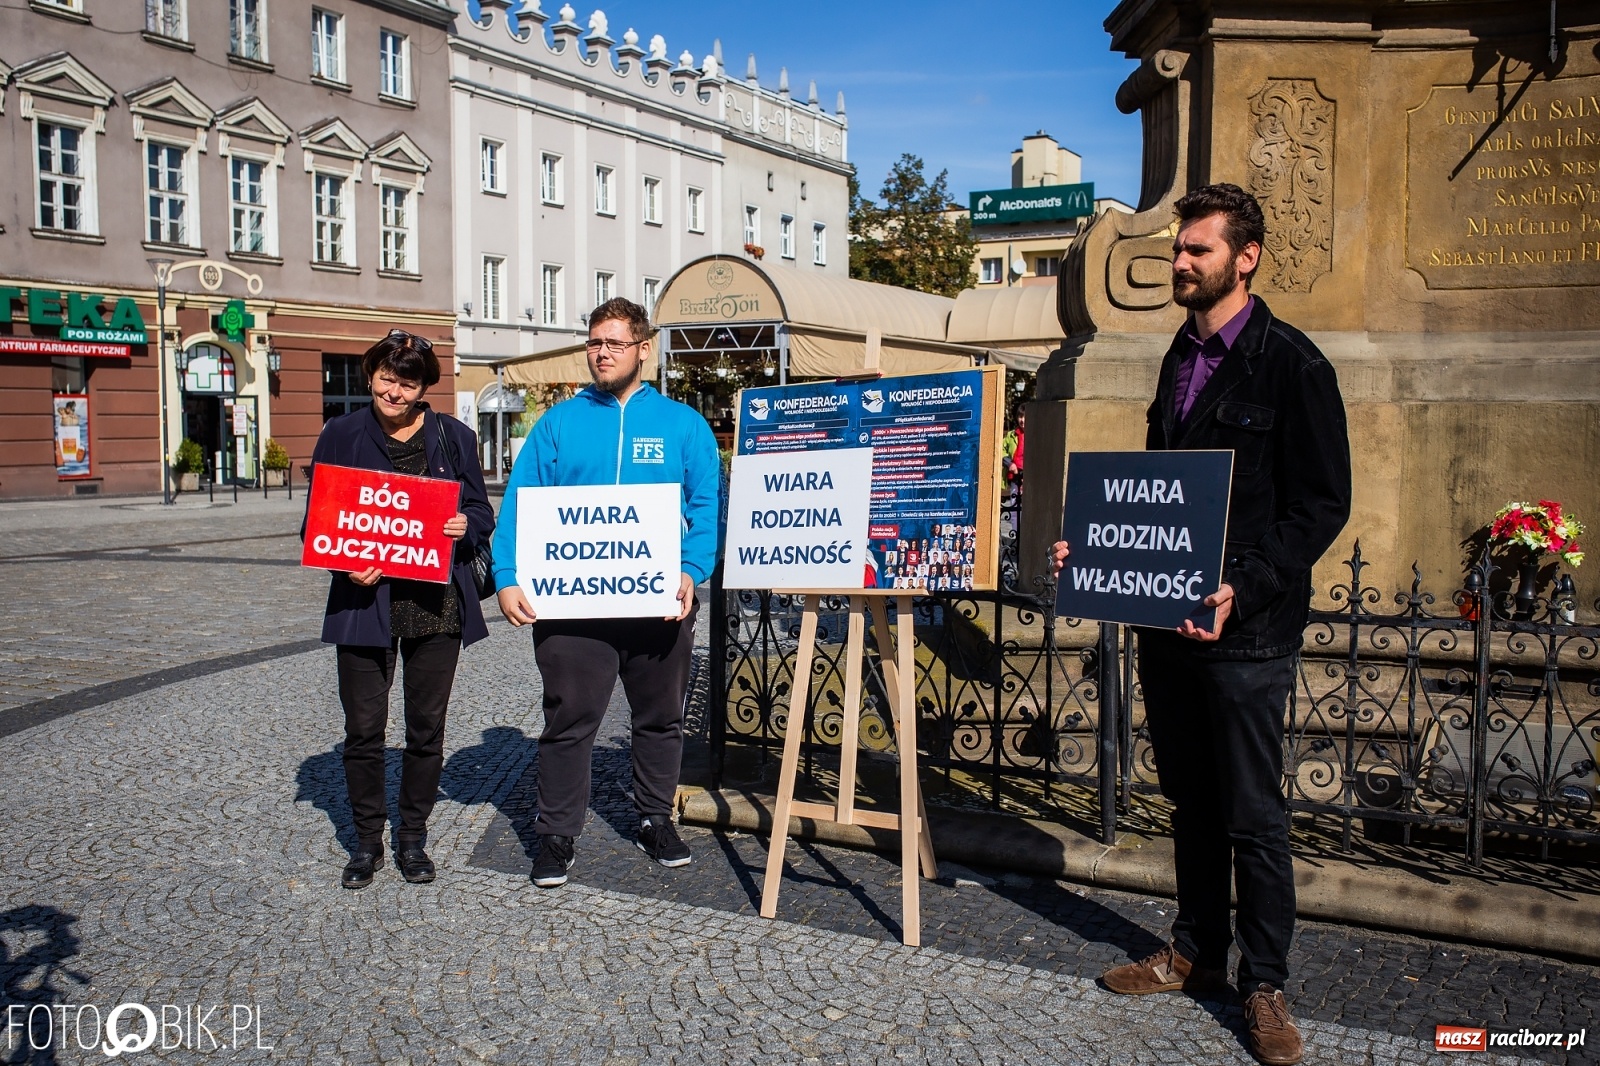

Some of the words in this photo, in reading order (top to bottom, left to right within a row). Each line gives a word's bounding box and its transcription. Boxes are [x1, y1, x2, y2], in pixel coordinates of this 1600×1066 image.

[1562, 160, 1600, 176] NES
[999, 196, 1062, 211] McDonald's
[68, 330, 94, 340] POD
[97, 331, 143, 342] RÓŻAMI
[0, 340, 38, 351] NTRUM
[40, 342, 127, 356] FARMACEUTYCZNE
[774, 394, 848, 410] KONFEDERACJA
[889, 385, 973, 402] KONFEDERACJA
[632, 444, 664, 458] FFS
[763, 470, 834, 493] WIARA
[1103, 478, 1185, 504] WIARA
[358, 482, 410, 510] BÓG
[337, 510, 424, 540] HONOR
[558, 505, 640, 526] WIARA
[750, 507, 842, 530] RODZINA
[1087, 522, 1193, 553] RODZINA
[313, 534, 440, 568] OJCZYZNA
[545, 540, 652, 560] RODZINA
[738, 540, 852, 566] WŁASNOŚĆ
[532, 572, 665, 596] WŁASNOŚĆ
[1072, 566, 1204, 601] WŁASNOŚĆ
